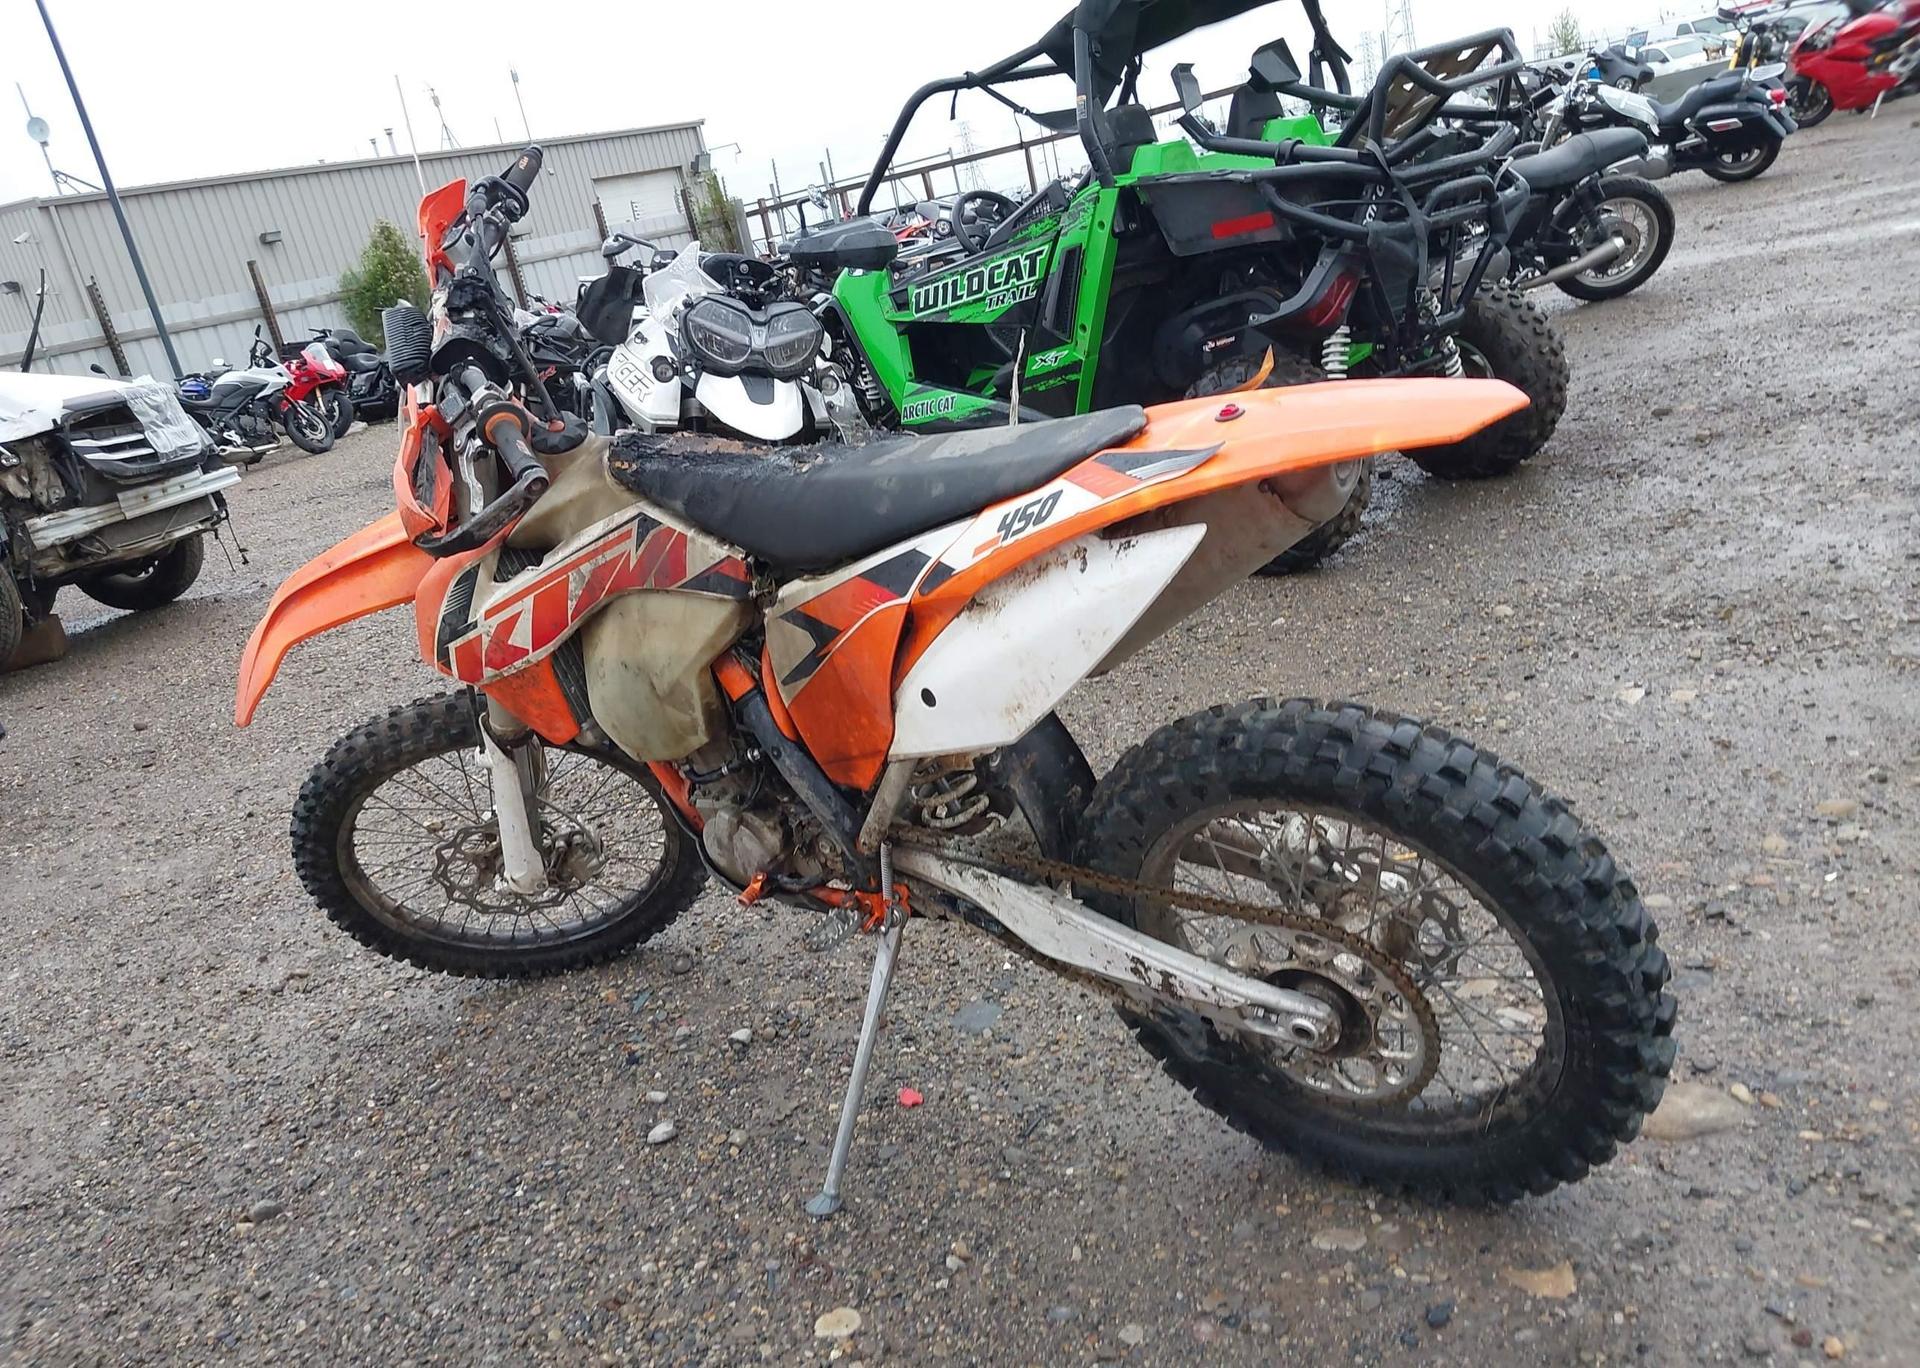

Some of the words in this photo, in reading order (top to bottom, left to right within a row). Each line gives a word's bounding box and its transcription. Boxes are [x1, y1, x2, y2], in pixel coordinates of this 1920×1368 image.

[912, 245, 1049, 317] WILDCAT
[985, 284, 1038, 312] TRAIL
[1031, 350, 1069, 370] XT
[901, 397, 936, 423] ARCTIC
[936, 393, 957, 416] CAT
[997, 489, 1063, 541] 450
